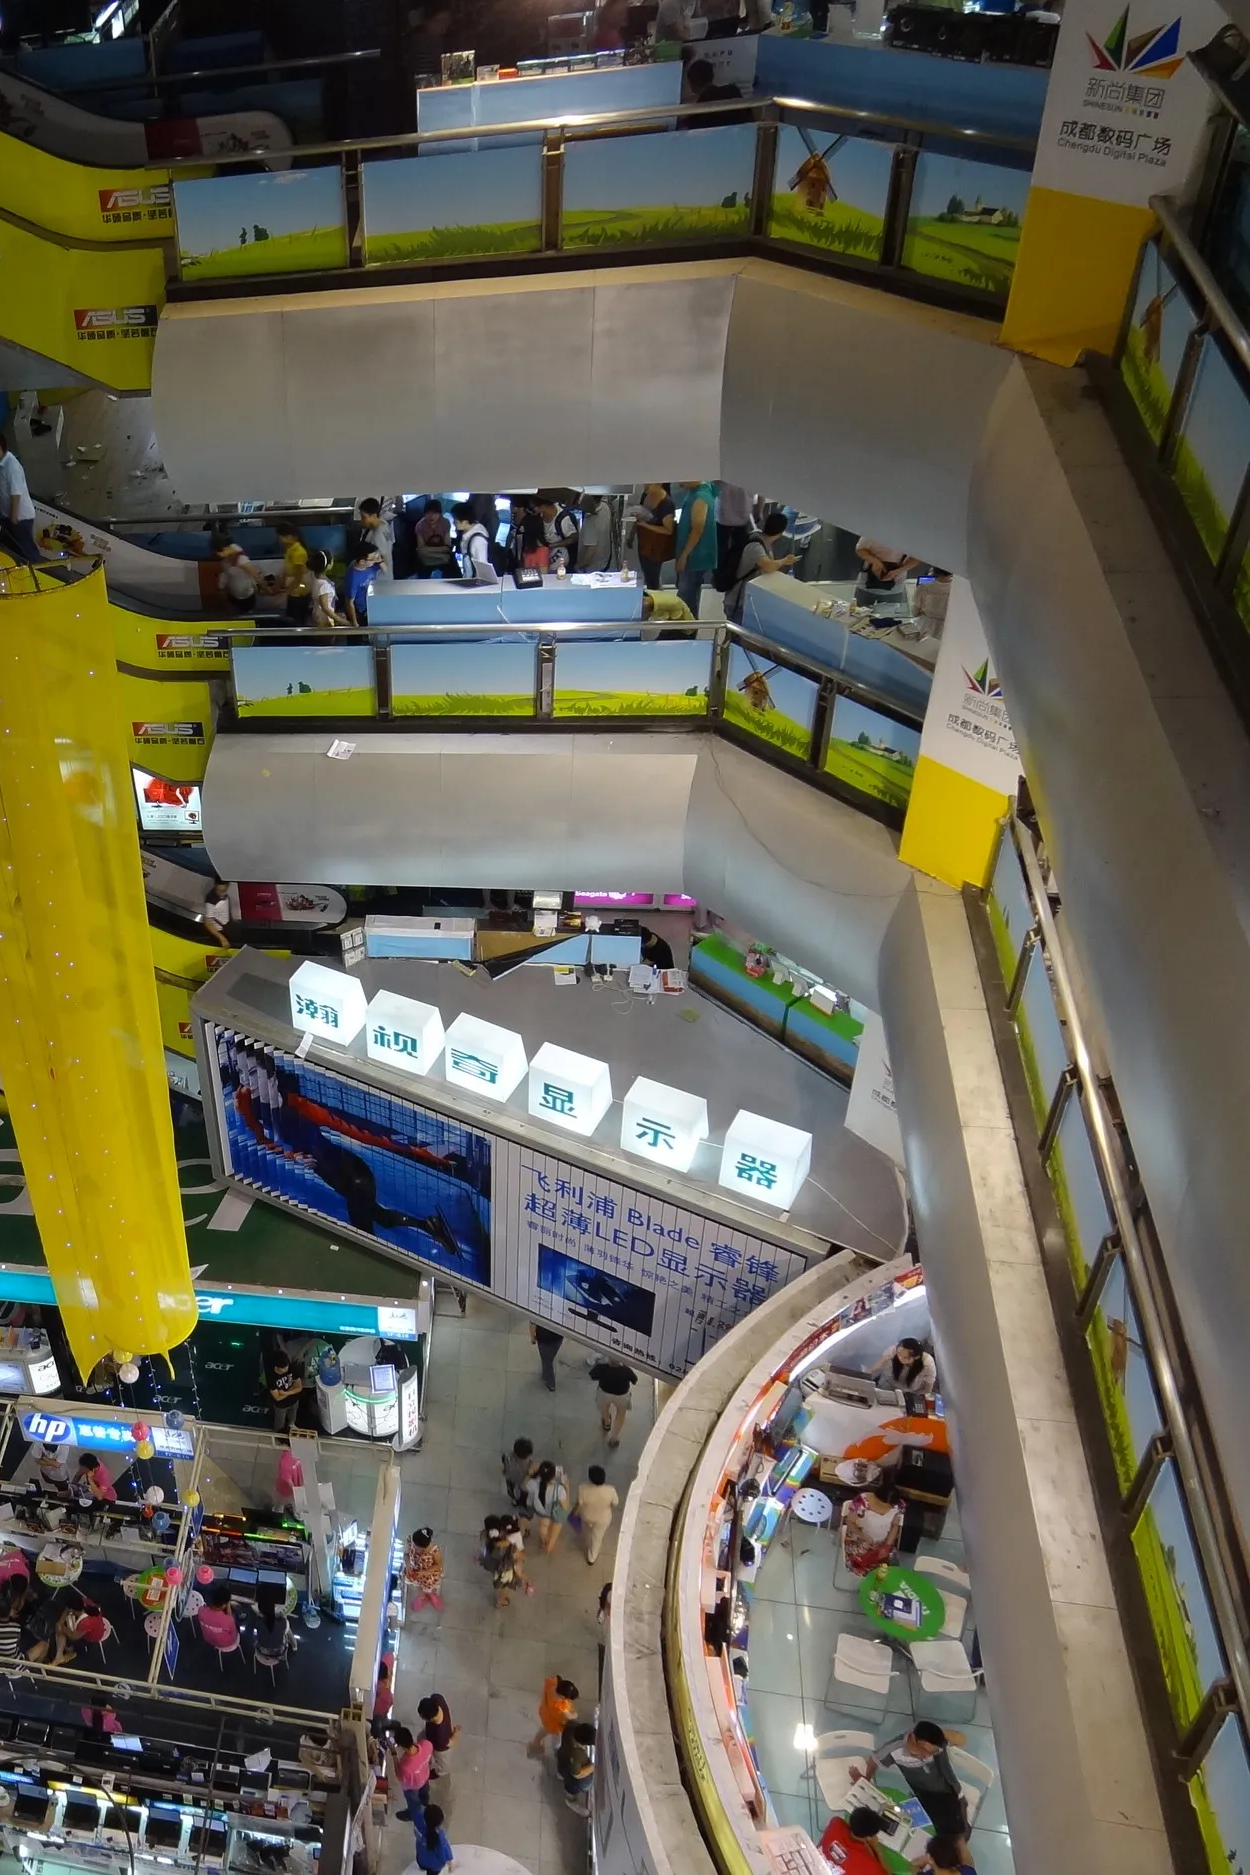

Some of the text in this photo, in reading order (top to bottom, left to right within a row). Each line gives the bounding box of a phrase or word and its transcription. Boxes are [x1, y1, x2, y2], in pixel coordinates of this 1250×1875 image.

[1086, 77, 1165, 109] 新尚集团
[1058, 137, 1167, 168] Chengdu Digital Plaza
[1059, 120, 1172, 156] 成都数码广场
[82, 308, 146, 327] ASUS
[162, 636, 219, 649] ASUS
[138, 723, 193, 735] ASUS
[521, 1164, 781, 1284] 飞利浦 Blade 睿锋
[523, 1192, 769, 1304] 超薄LED显示器
[205, 1360, 235, 1372] acer
[29, 1412, 67, 1442] hp
